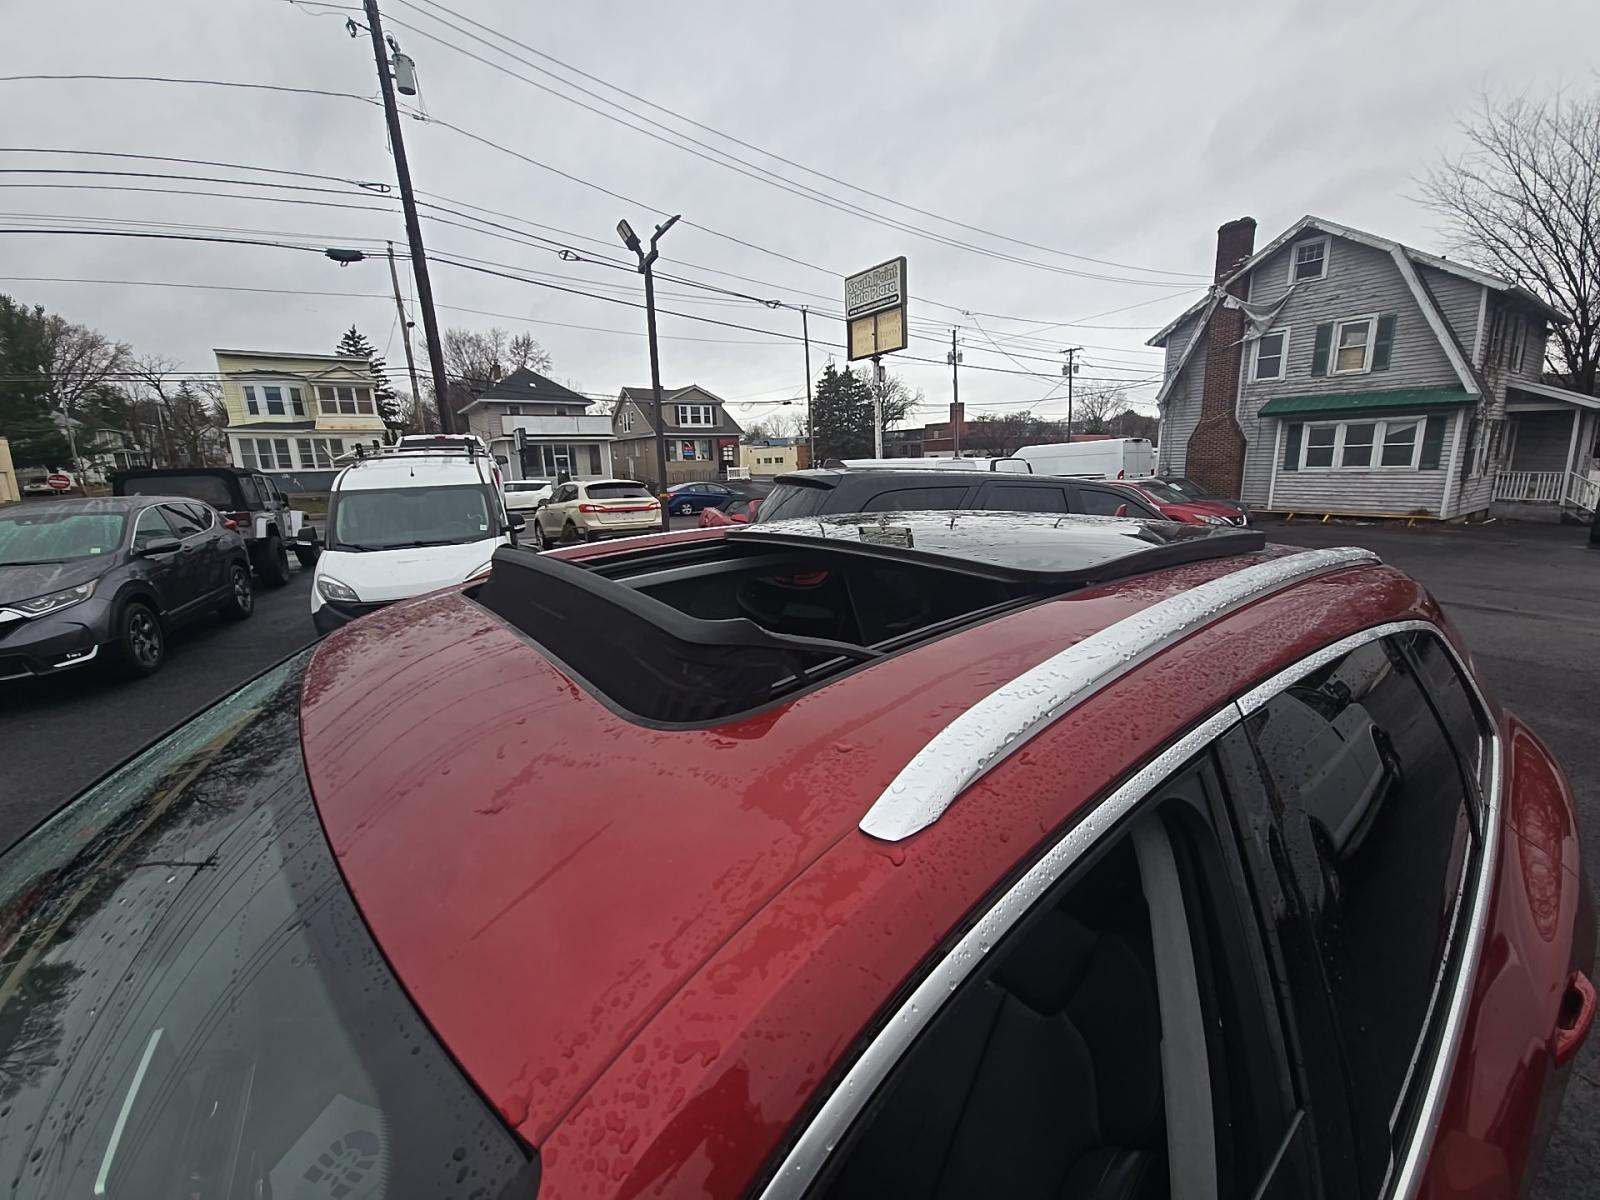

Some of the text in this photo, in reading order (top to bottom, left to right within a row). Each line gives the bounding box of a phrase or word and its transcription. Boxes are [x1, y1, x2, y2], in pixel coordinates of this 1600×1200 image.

[848, 265, 897, 293] South Point
[848, 290, 869, 307] Auto
[869, 281, 897, 299] Plaza
